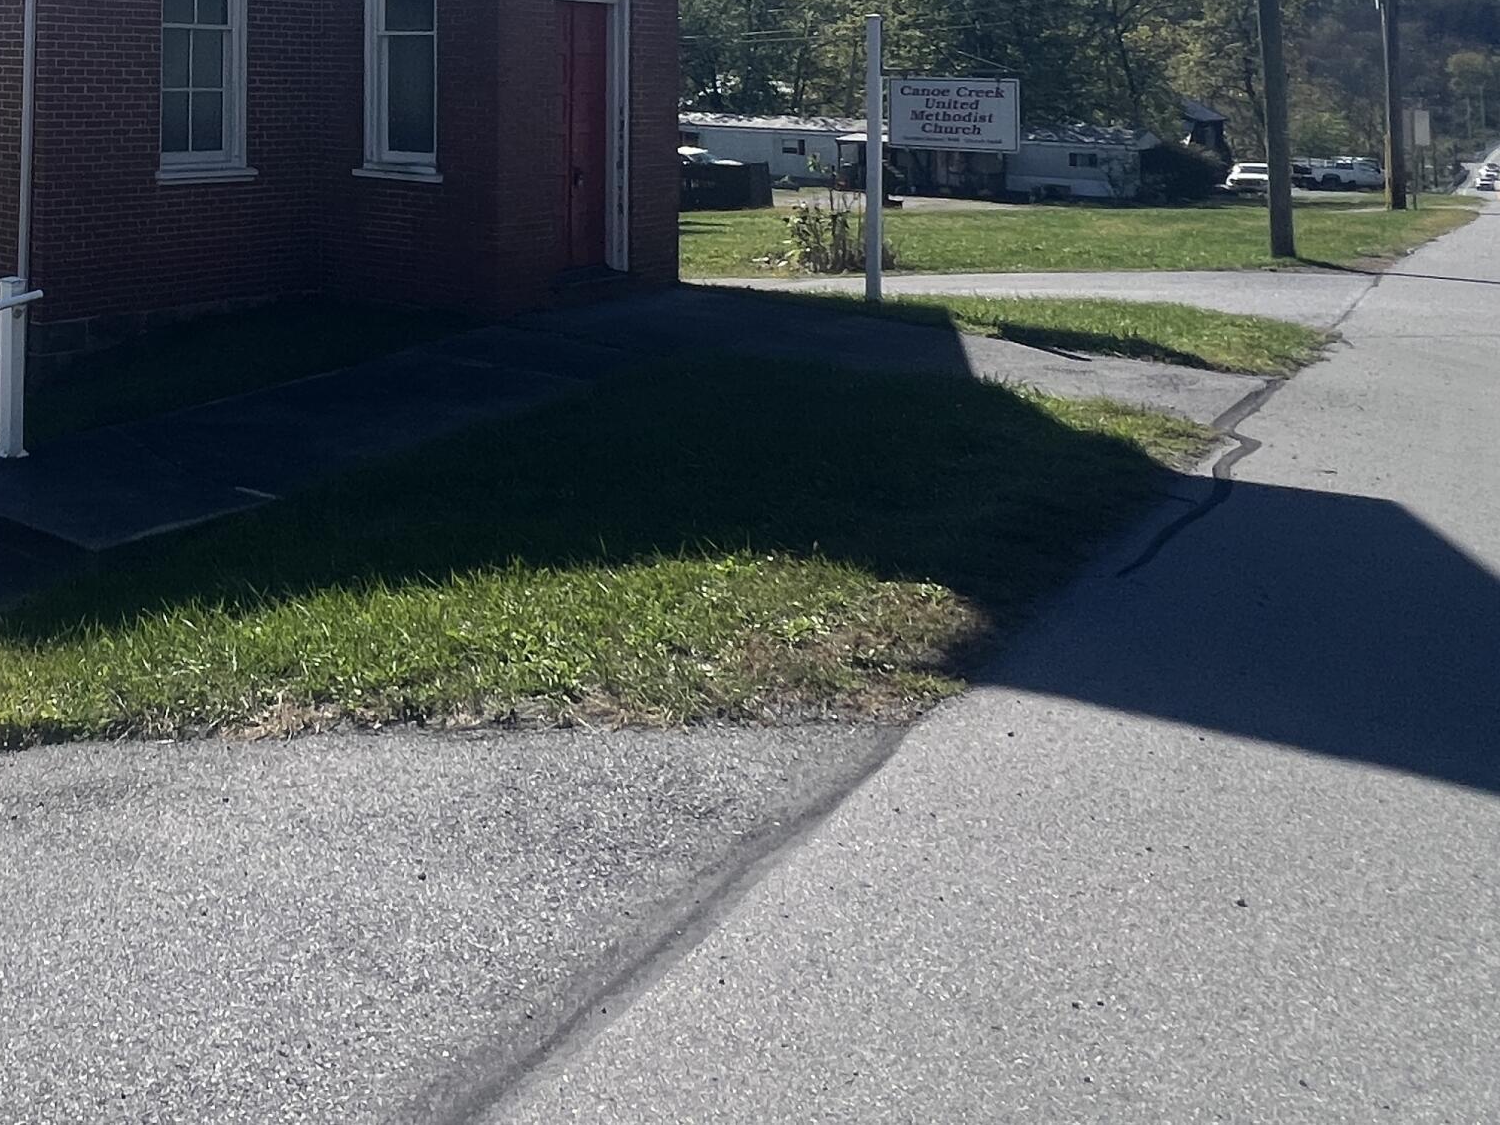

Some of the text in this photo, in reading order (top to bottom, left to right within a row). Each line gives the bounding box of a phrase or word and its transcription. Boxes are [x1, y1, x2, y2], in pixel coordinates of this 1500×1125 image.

[900, 85, 1005, 98] Canoe Creek
[925, 98, 979, 110] United
[910, 110, 993, 123] Methodist
[921, 123, 981, 135] Church
